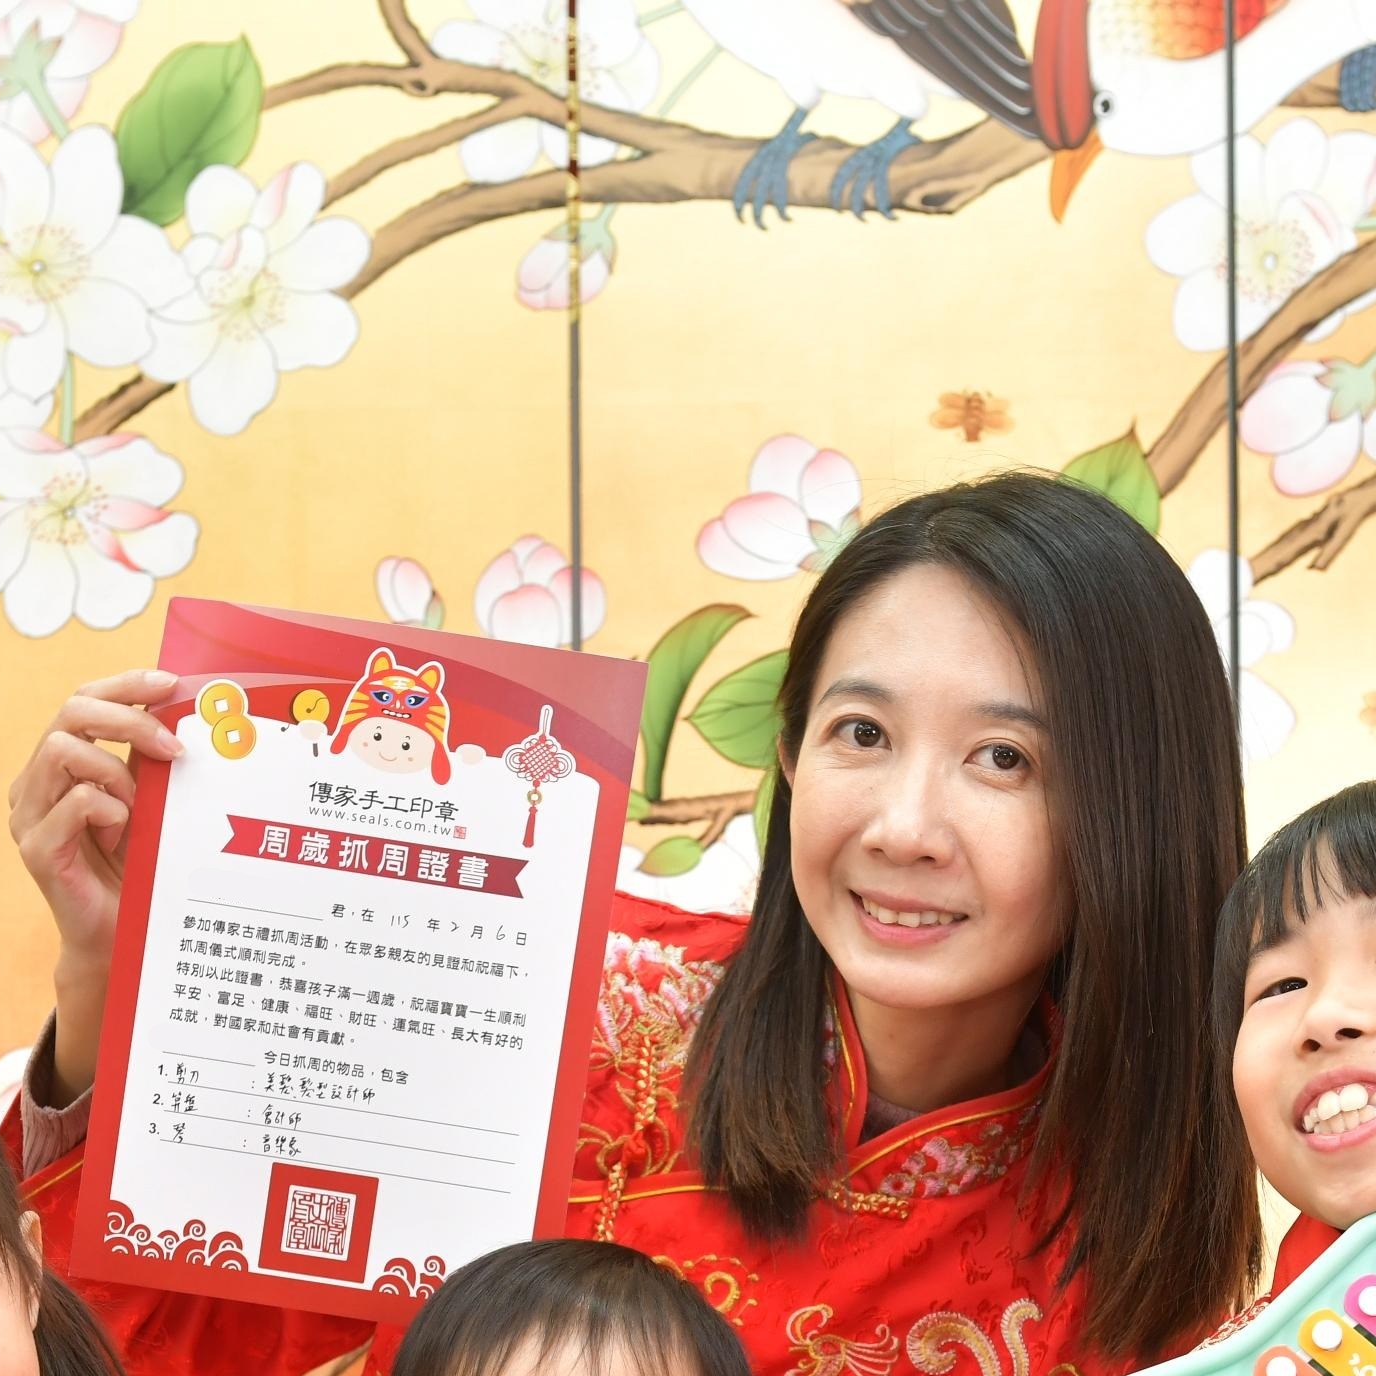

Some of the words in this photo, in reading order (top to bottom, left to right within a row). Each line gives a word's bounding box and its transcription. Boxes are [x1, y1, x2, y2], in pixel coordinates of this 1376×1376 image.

[309, 781, 459, 823] 傳家手工印章
[309, 805, 452, 836] www.seals.com.tw
[257, 823, 490, 889] 周歲抓周證書
[391, 914, 410, 928] 115
[427, 918, 440, 932] 年
[471, 926, 483, 940] 月
[497, 925, 505, 941] 6
[516, 932, 527, 946] 日
[157, 1065, 168, 1077] 1.
[176, 1063, 199, 1084] 剪刀
[264, 1051, 409, 1085] 今日抓周的物品，包含
[152, 1094, 164, 1106] 2.
[148, 1123, 160, 1135] 3.
